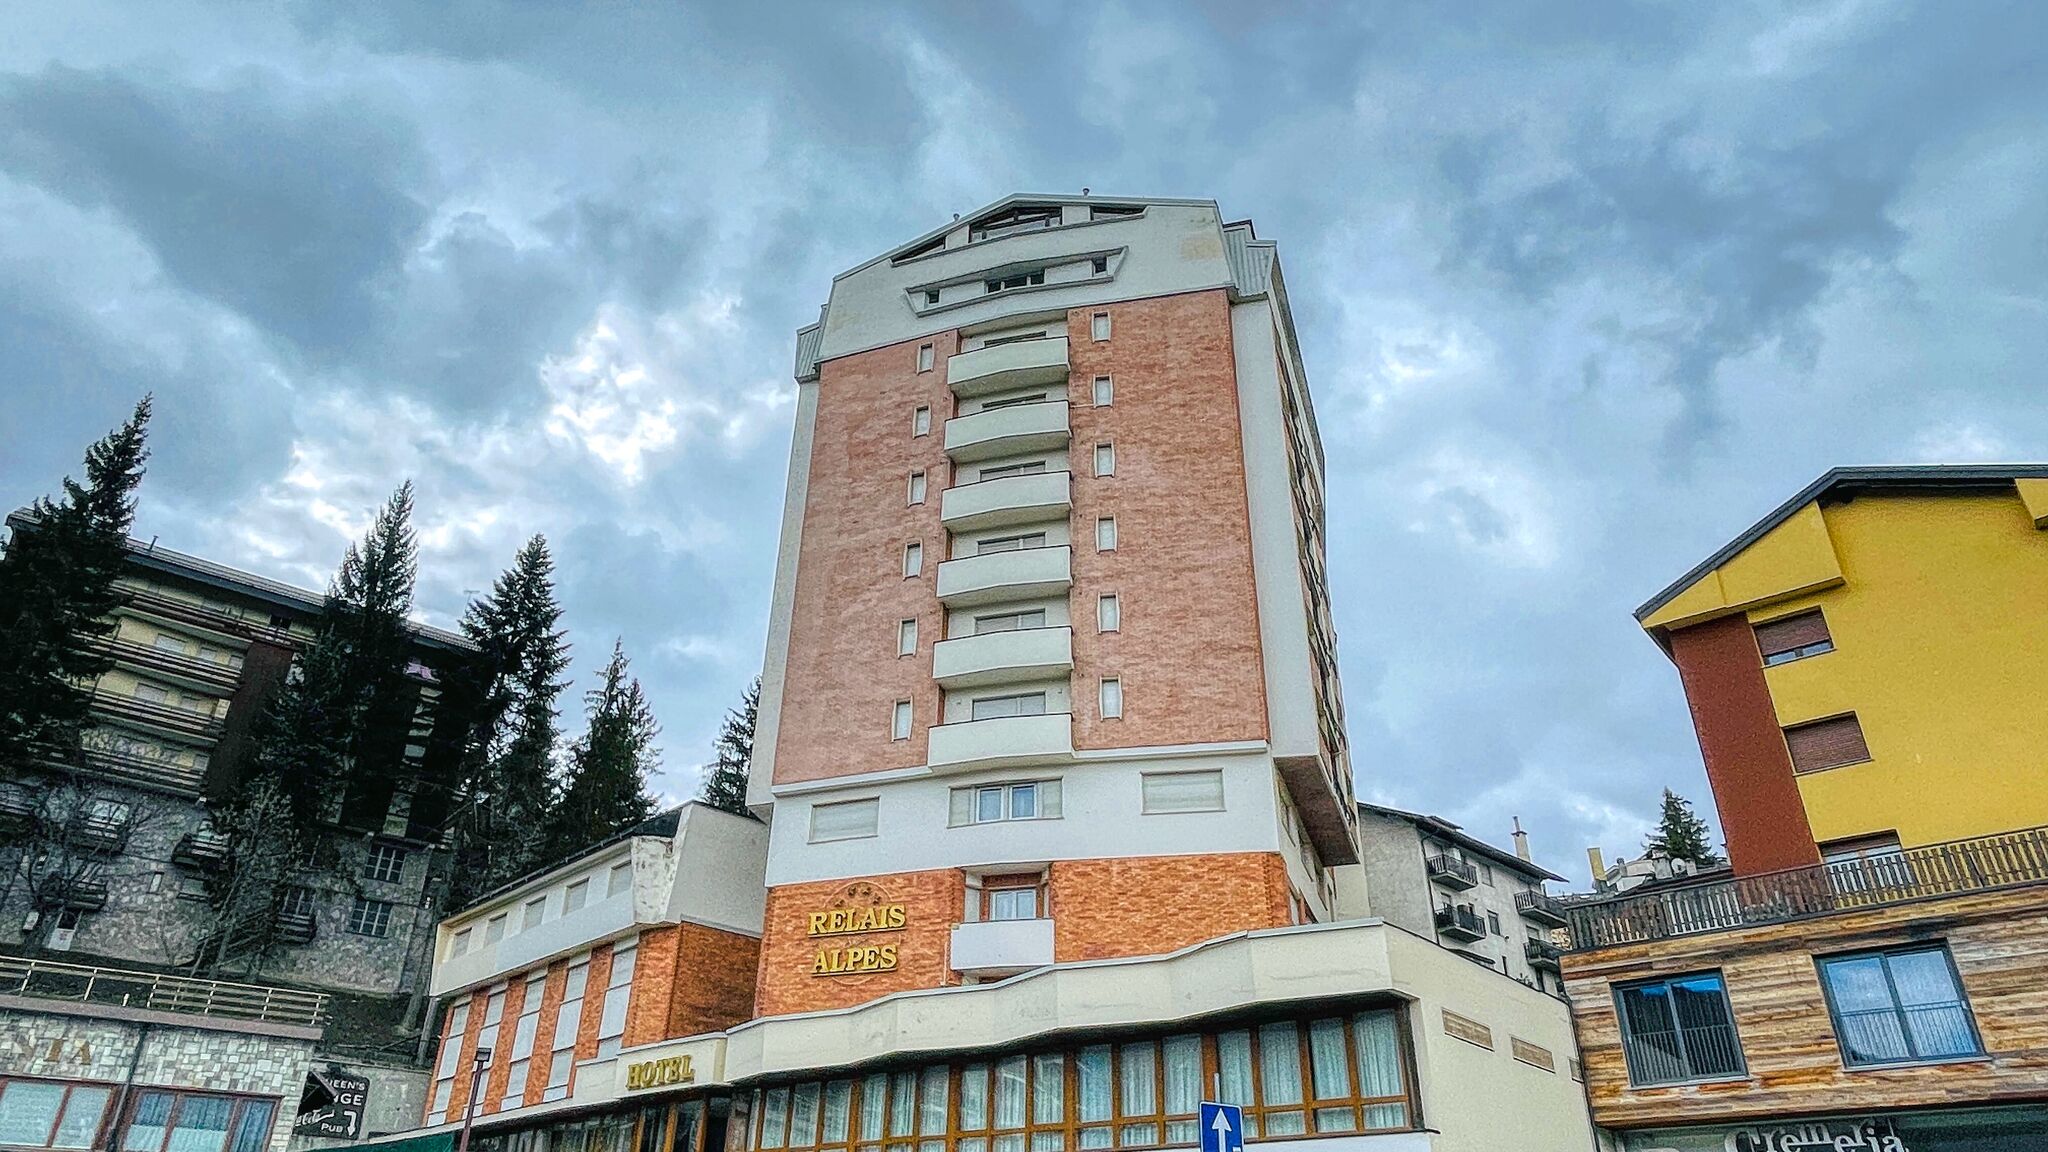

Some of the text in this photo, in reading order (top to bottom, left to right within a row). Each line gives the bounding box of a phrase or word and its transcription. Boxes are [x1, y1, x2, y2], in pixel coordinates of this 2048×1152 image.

[808, 903, 906, 935] RELAIS
[811, 944, 897, 974] ALPES
[626, 1055, 694, 1090] HOTEL
[320, 1122, 344, 1133] PUB
